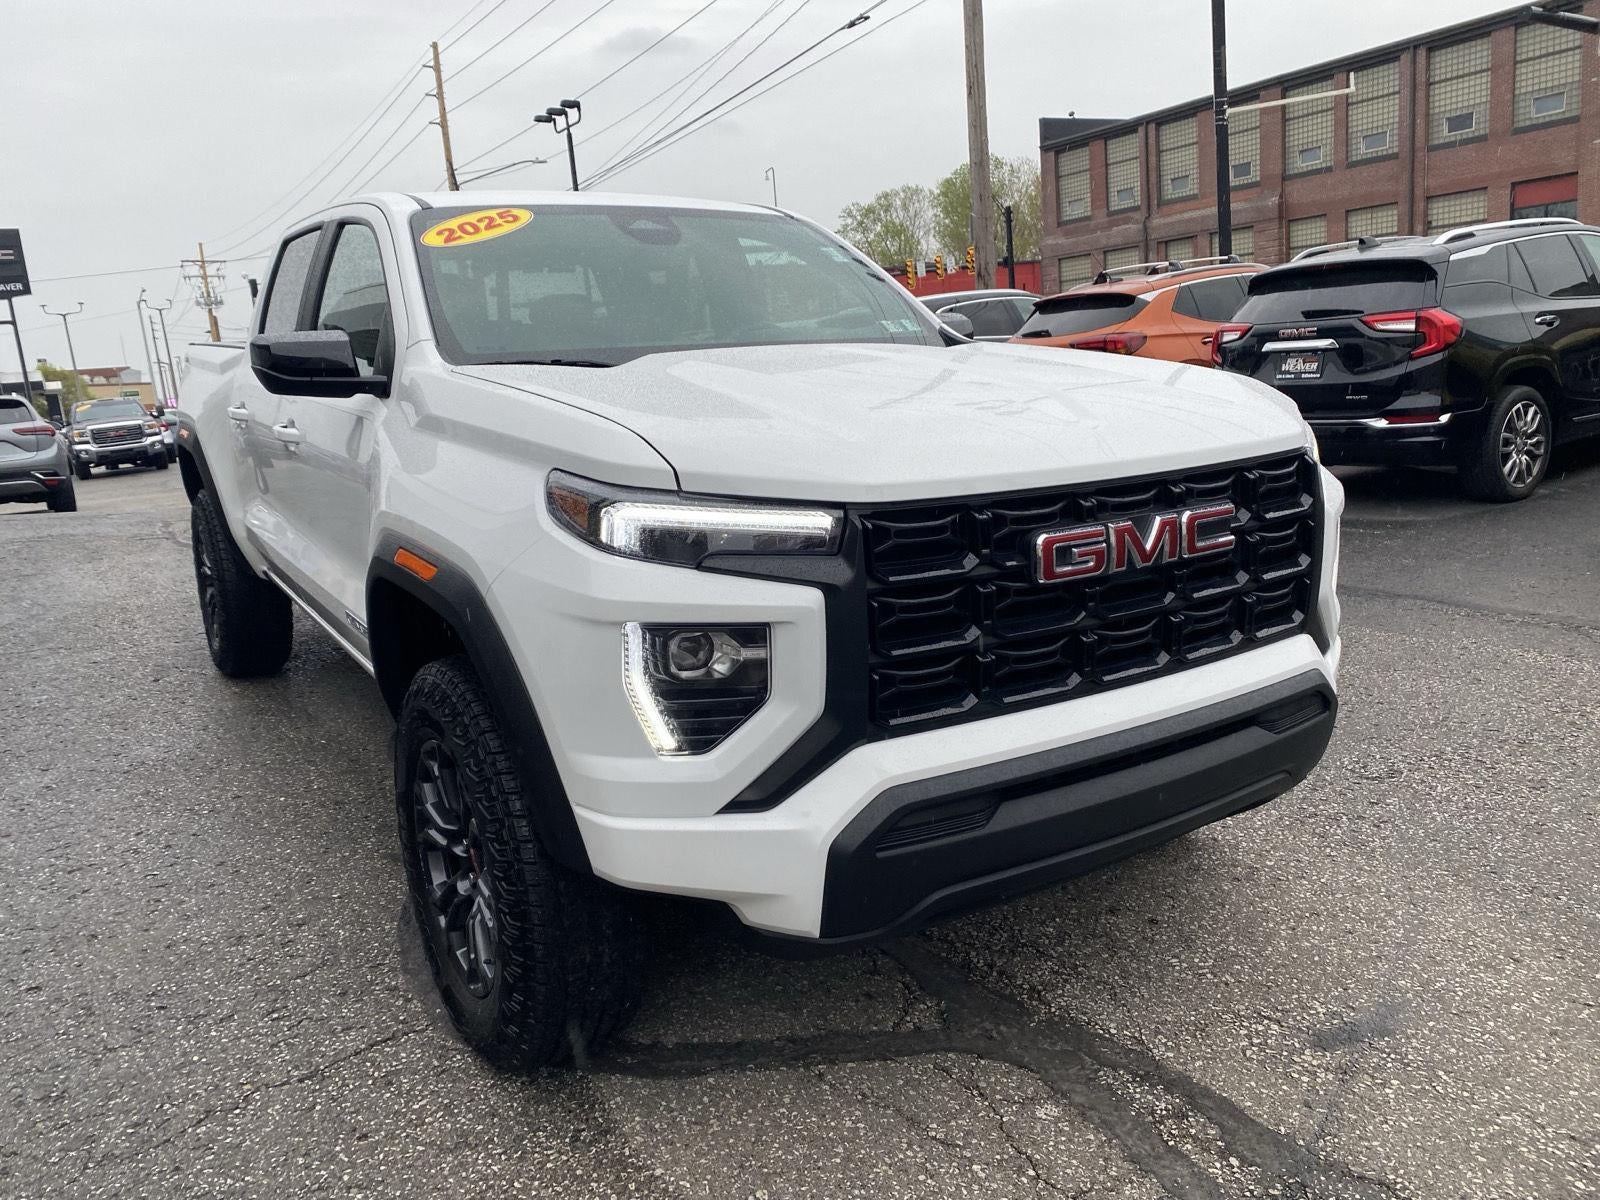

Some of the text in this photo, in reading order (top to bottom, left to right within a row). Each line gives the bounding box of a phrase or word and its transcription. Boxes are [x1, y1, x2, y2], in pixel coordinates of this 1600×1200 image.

[436, 210, 520, 244] 2025
[1279, 327, 1317, 338] GMC
[1281, 362, 1319, 371] WEAVER
[1036, 501, 1236, 583] GMC
